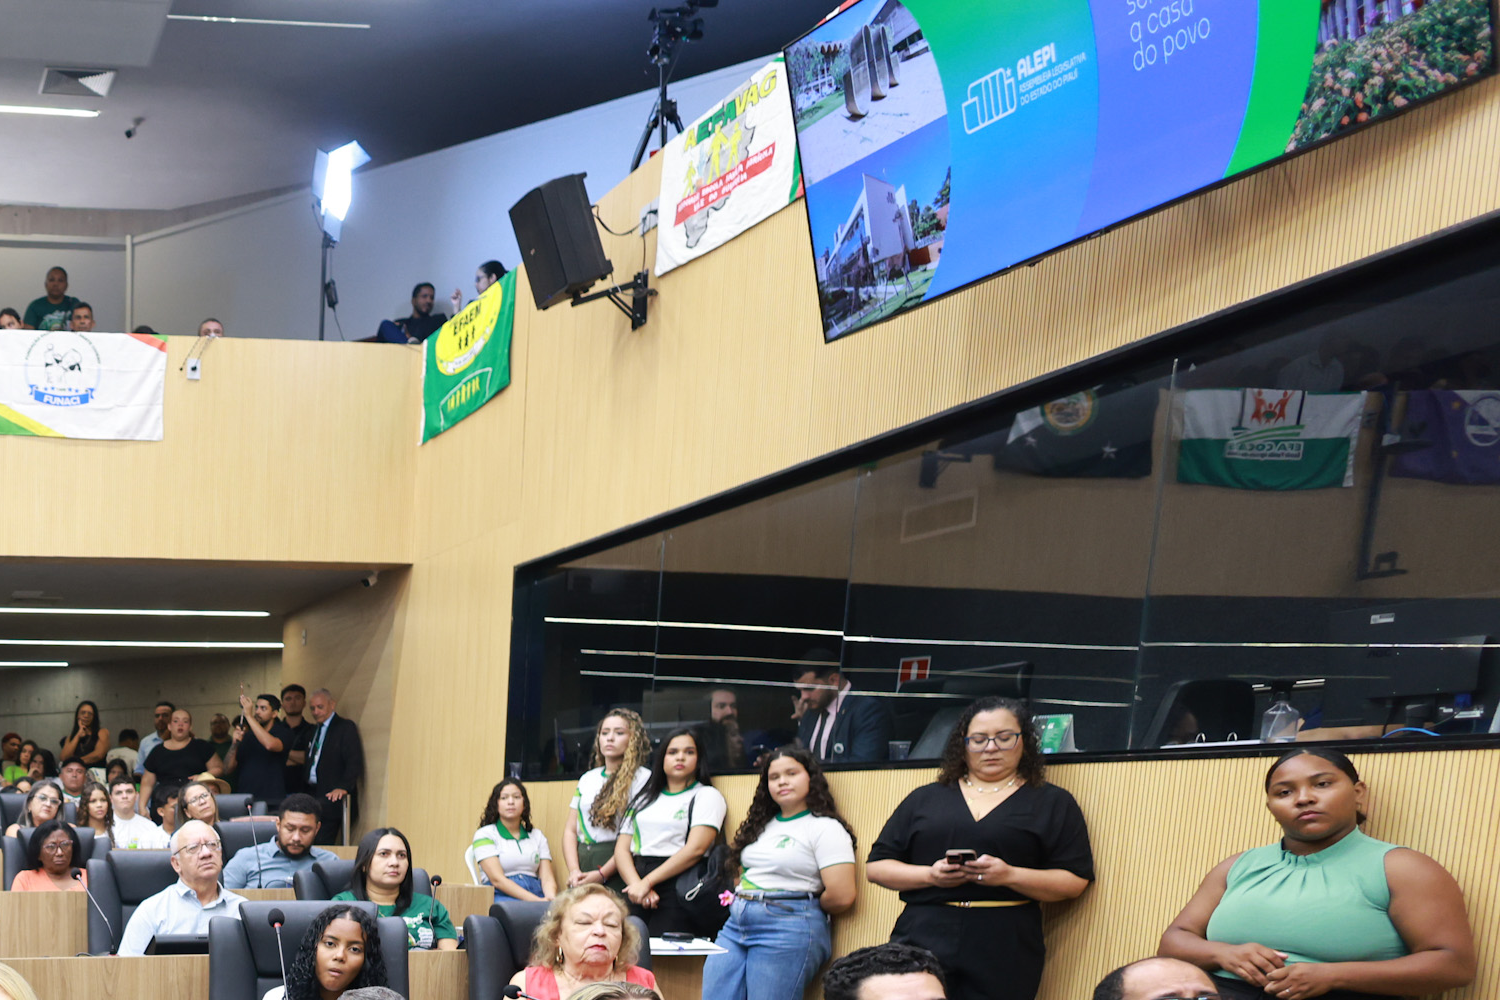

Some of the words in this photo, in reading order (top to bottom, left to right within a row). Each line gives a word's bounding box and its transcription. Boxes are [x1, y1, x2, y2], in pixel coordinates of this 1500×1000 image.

[1129, 21, 1142, 43] a
[1147, 0, 1194, 34] casa
[1016, 42, 1057, 81] ALEPI
[1133, 41, 1157, 71] do
[1163, 18, 1211, 64] povo
[1019, 70, 1051, 93] ASSEMBLEIA
[1051, 52, 1087, 77] LEGISLATIVA
[1020, 94, 1029, 106] DO
[1030, 83, 1052, 101] ESTADO
[1053, 78, 1063, 90] DO
[684, 69, 777, 152] AEFAVAG
[43, 394, 80, 406] FUNACI
